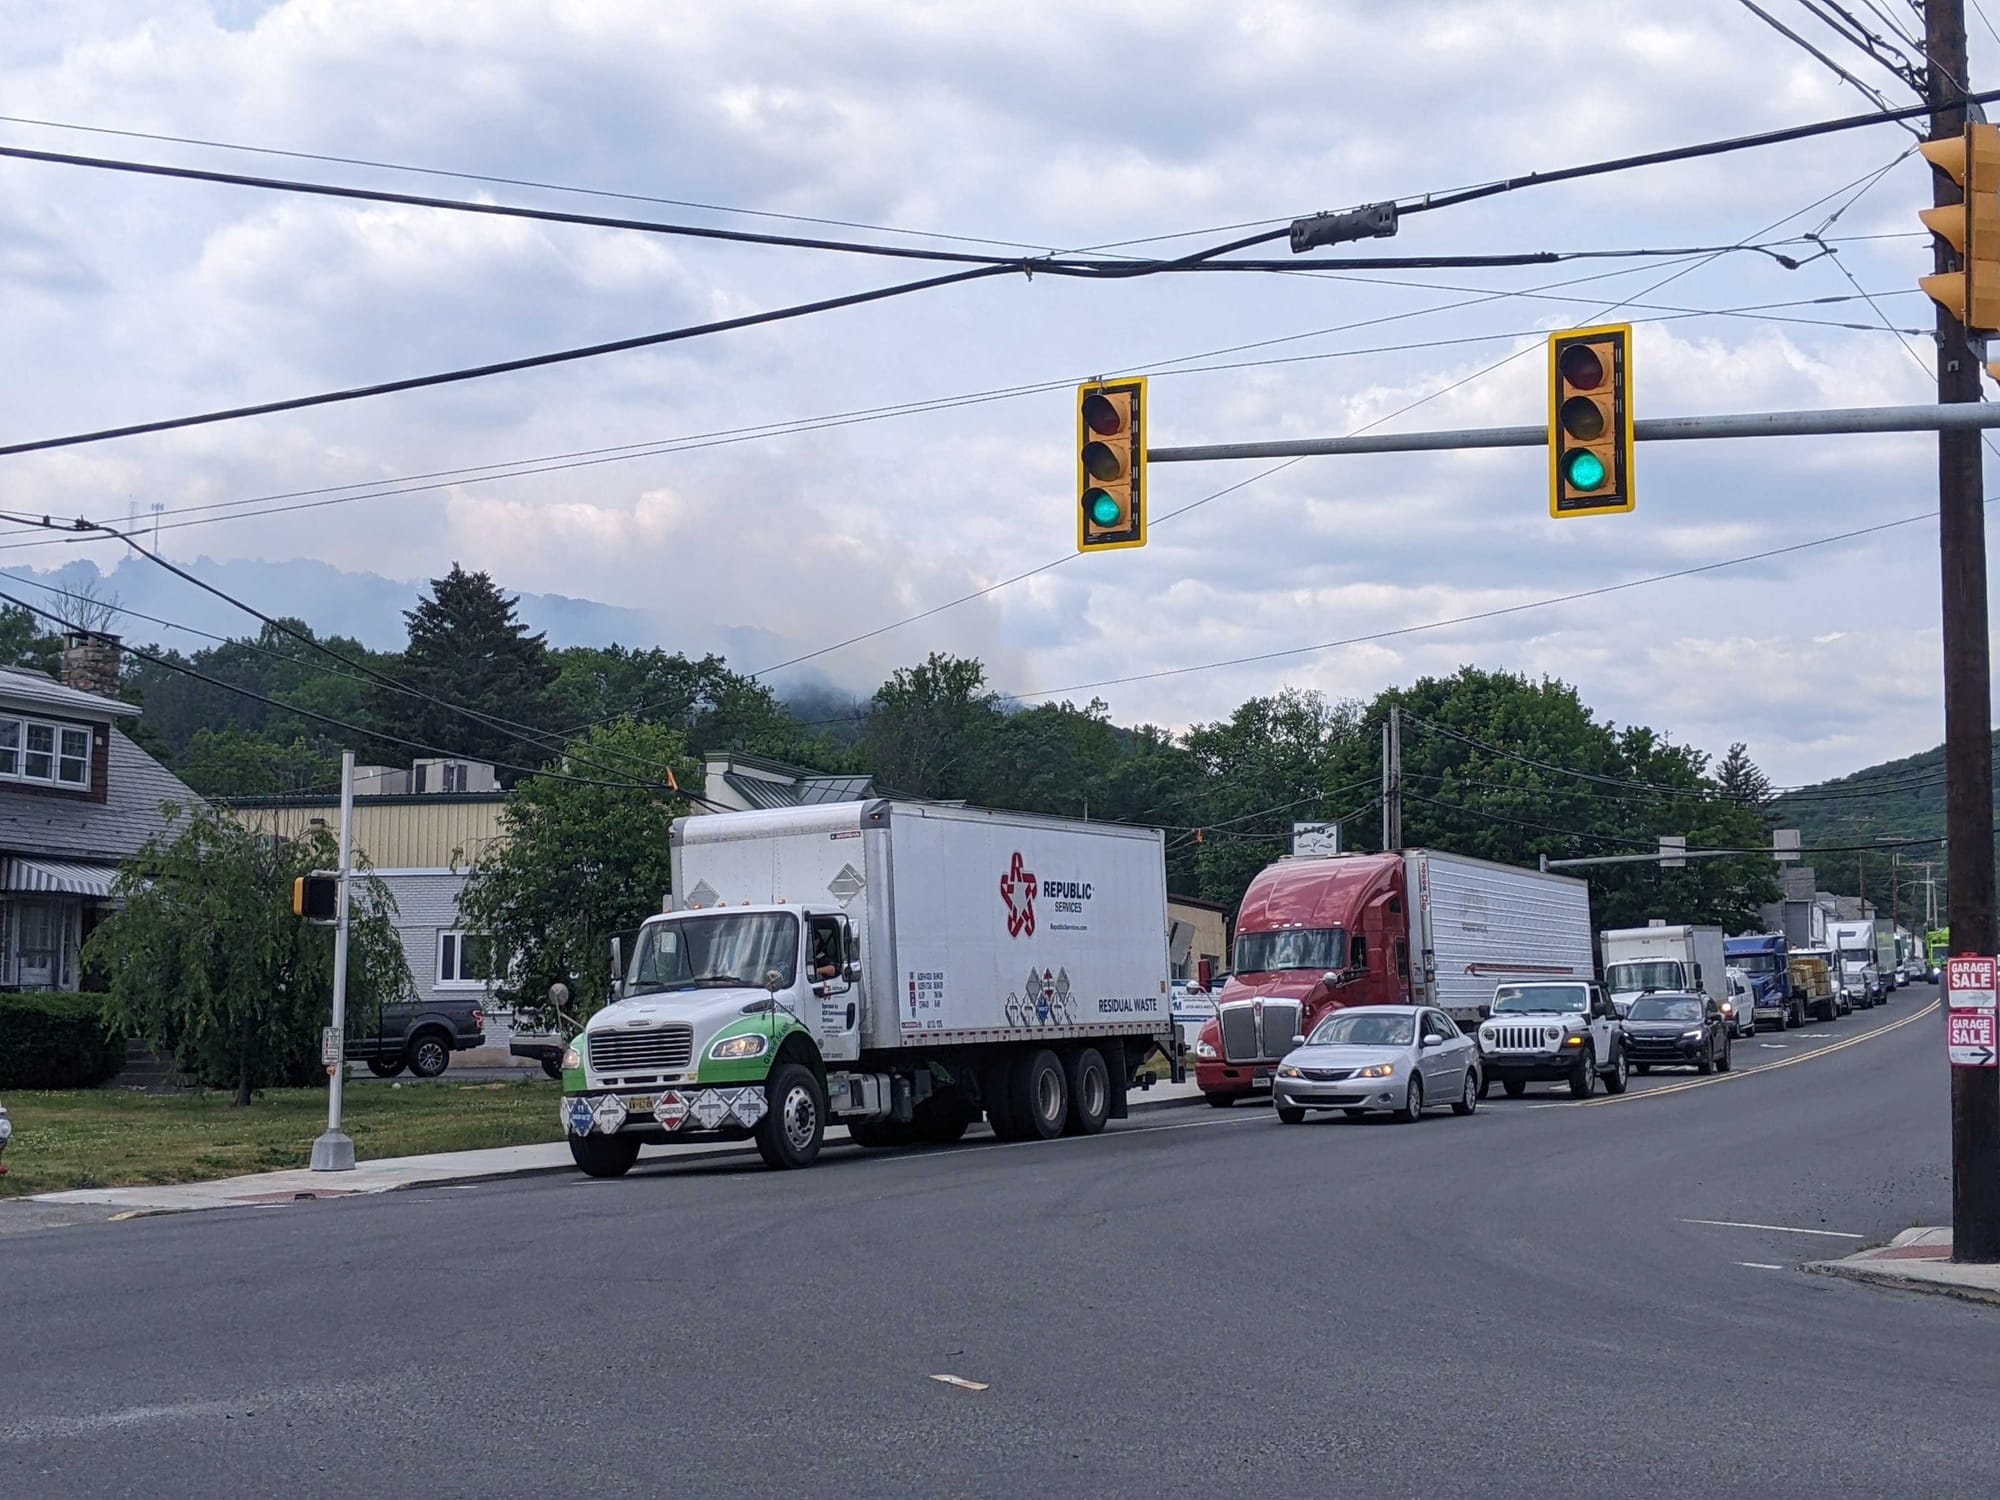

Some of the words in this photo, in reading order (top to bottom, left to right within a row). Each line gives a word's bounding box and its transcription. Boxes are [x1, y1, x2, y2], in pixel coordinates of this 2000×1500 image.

[1043, 880, 1093, 900] REPUBLIC
[1054, 901, 1083, 913] SERVICES
[1951, 962, 1991, 973] GARAGE
[1952, 973, 1991, 988] SALE
[1098, 999, 1133, 1013] RESIDUAL
[1134, 998, 1158, 1011] WASTE
[1952, 1019, 1990, 1029] GARAGE
[1952, 1030, 1990, 1044] SALE
